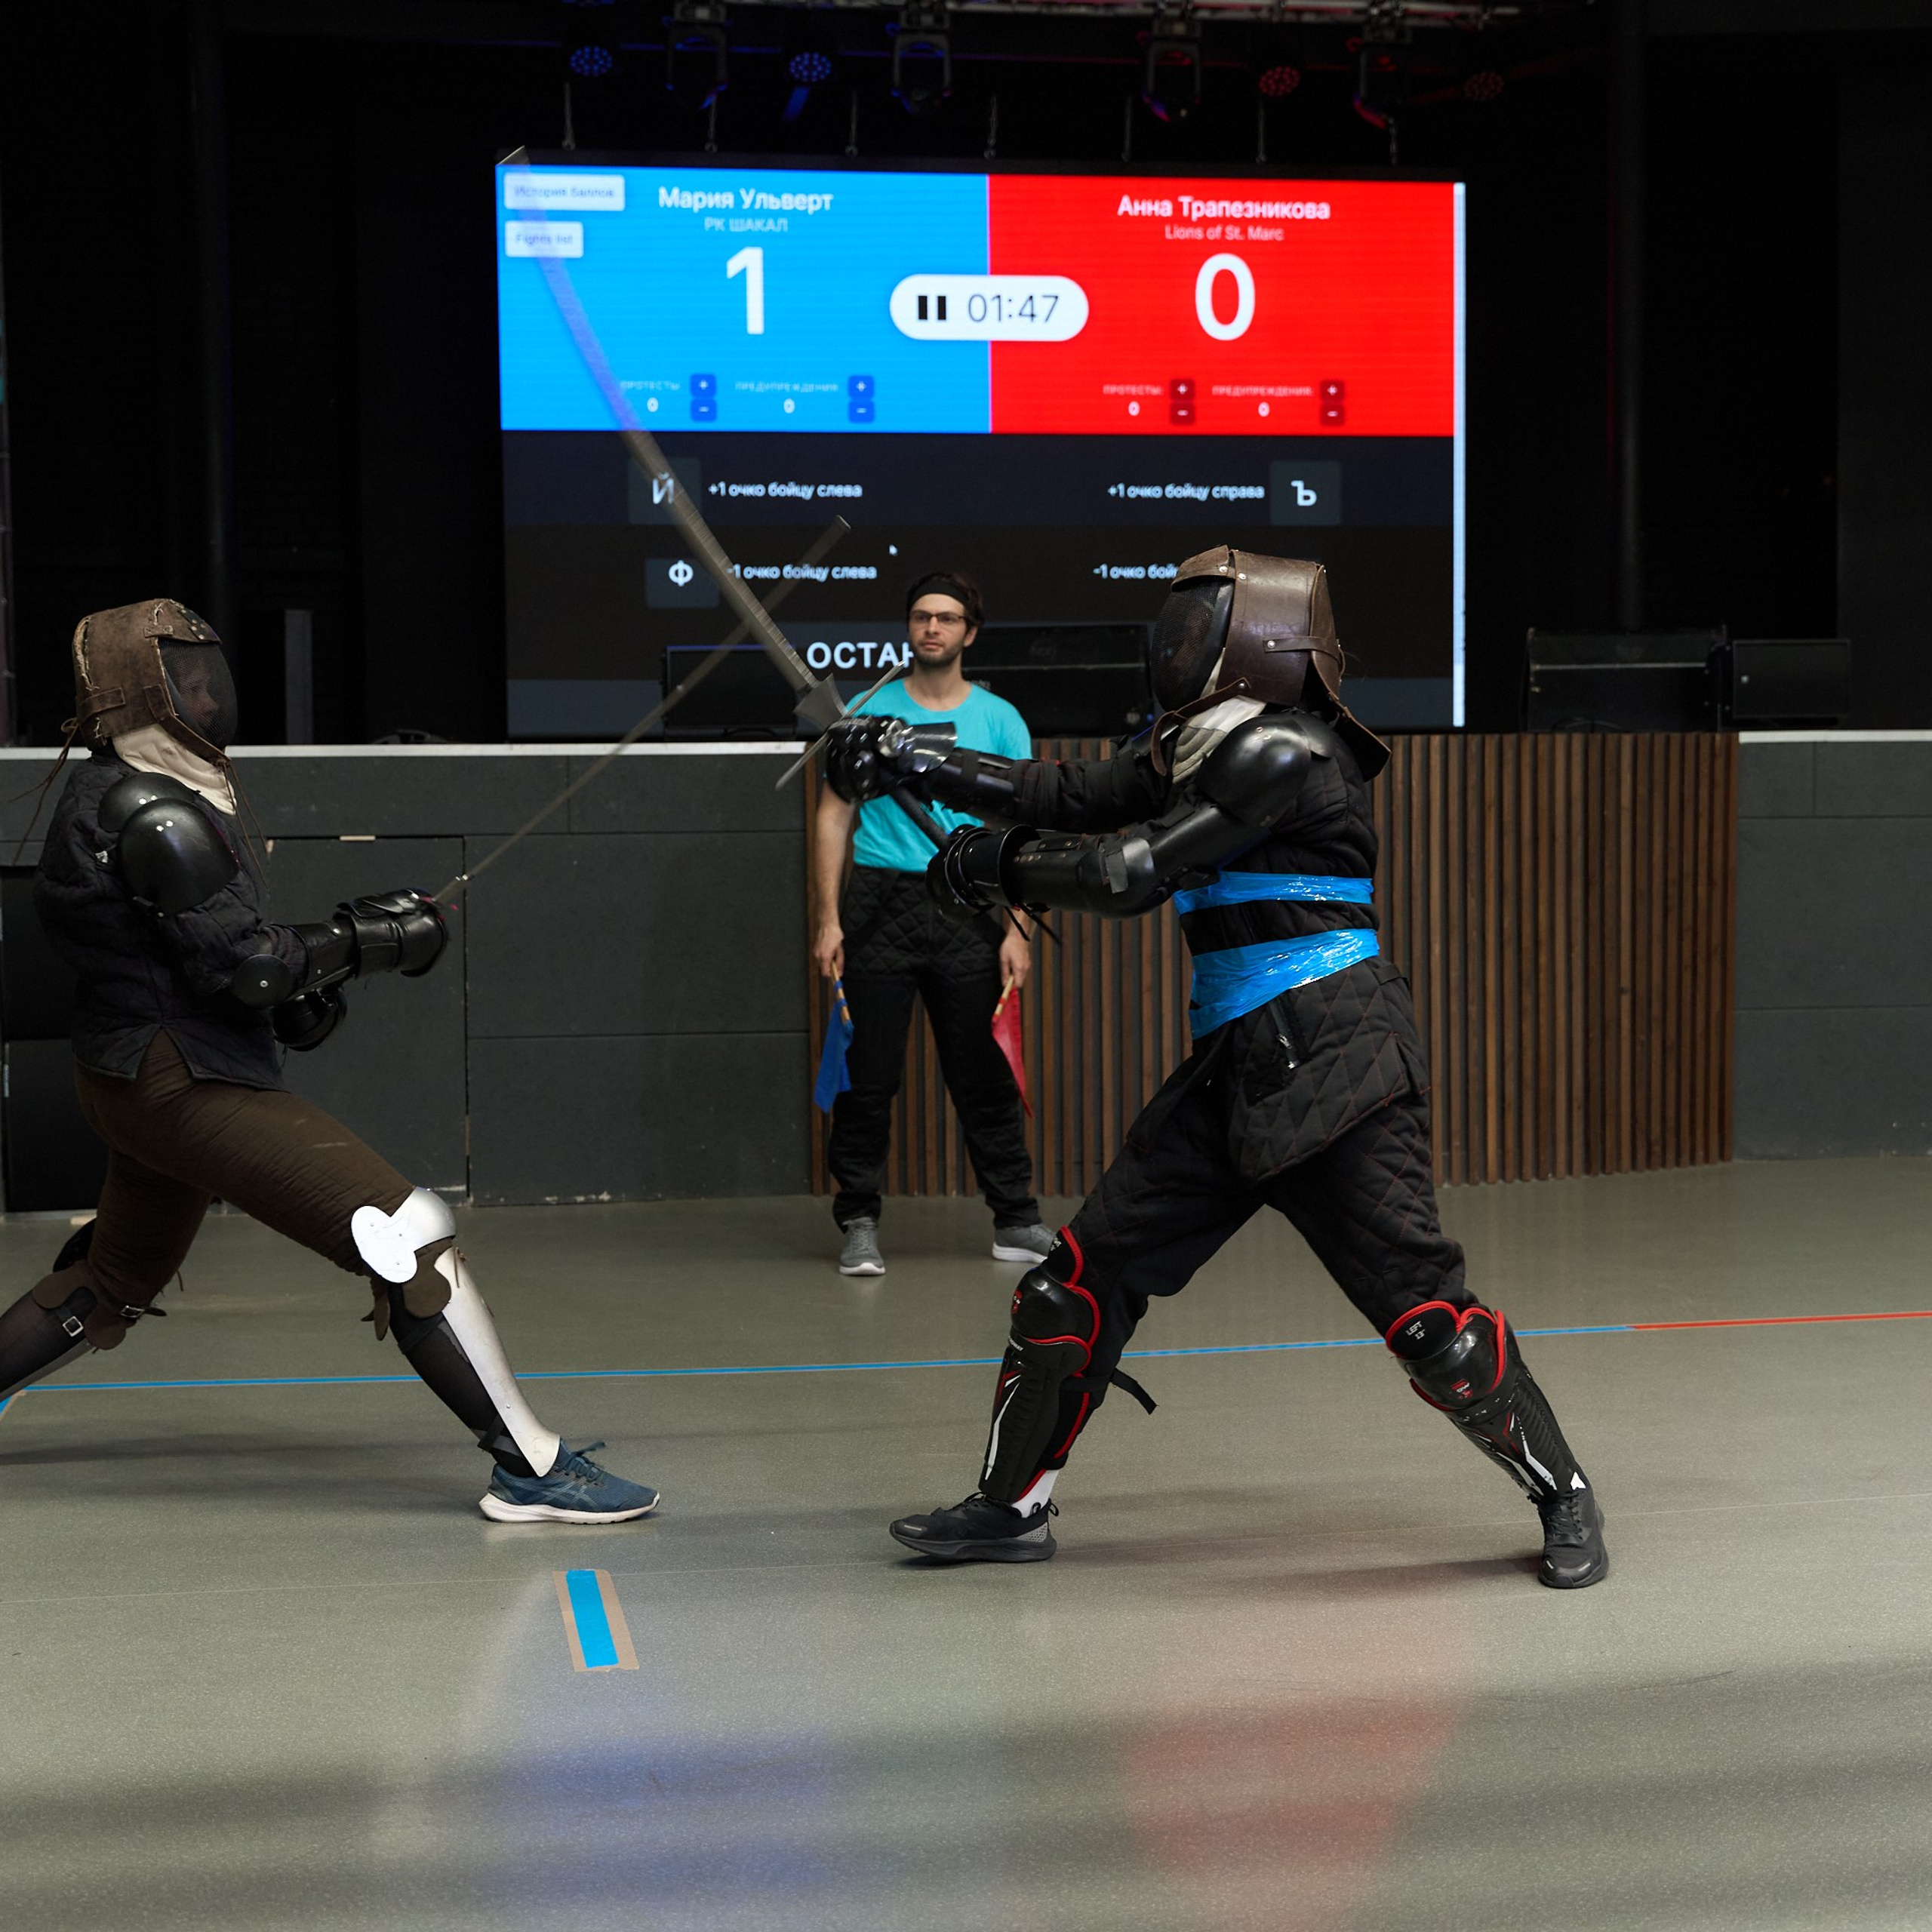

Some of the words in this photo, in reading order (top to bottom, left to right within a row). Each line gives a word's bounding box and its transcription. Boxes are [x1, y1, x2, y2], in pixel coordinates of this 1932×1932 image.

[659, 186, 734, 213] Мария
[740, 188, 834, 214] Ульверт
[1117, 194, 1173, 217] Анна
[1178, 195, 1331, 221] Трапезникова
[704, 217, 725, 232] РК
[729, 217, 788, 232] ШАКАЛ
[1164, 225, 1204, 240] Lions
[1208, 225, 1222, 240] of
[1224, 226, 1244, 241] St.
[1247, 226, 1284, 241] Marc
[727, 246, 764, 334] 1
[1195, 252, 1256, 341] 0
[968, 294, 1060, 322] 01:47
[647, 397, 659, 413] 0
[783, 398, 795, 414] 0
[1128, 401, 1140, 417] 0
[1258, 402, 1270, 417] 0
[653, 472, 675, 504] Й
[708, 481, 726, 497] +1
[728, 484, 766, 497] очко
[768, 481, 815, 500] бойцу
[817, 485, 863, 498] слева
[1107, 483, 1124, 498] +1
[1127, 485, 1163, 499] очко
[1164, 482, 1210, 501] бойцу
[1211, 485, 1265, 501] справа
[1291, 480, 1317, 506] Ъ
[668, 560, 694, 586] Ф
[743, 565, 780, 580] очко
[783, 564, 829, 583] бойцу
[831, 566, 877, 580] слева
[1093, 564, 1108, 579] -1
[1109, 566, 1146, 580] очко
[1147, 564, 1180, 579] бой
